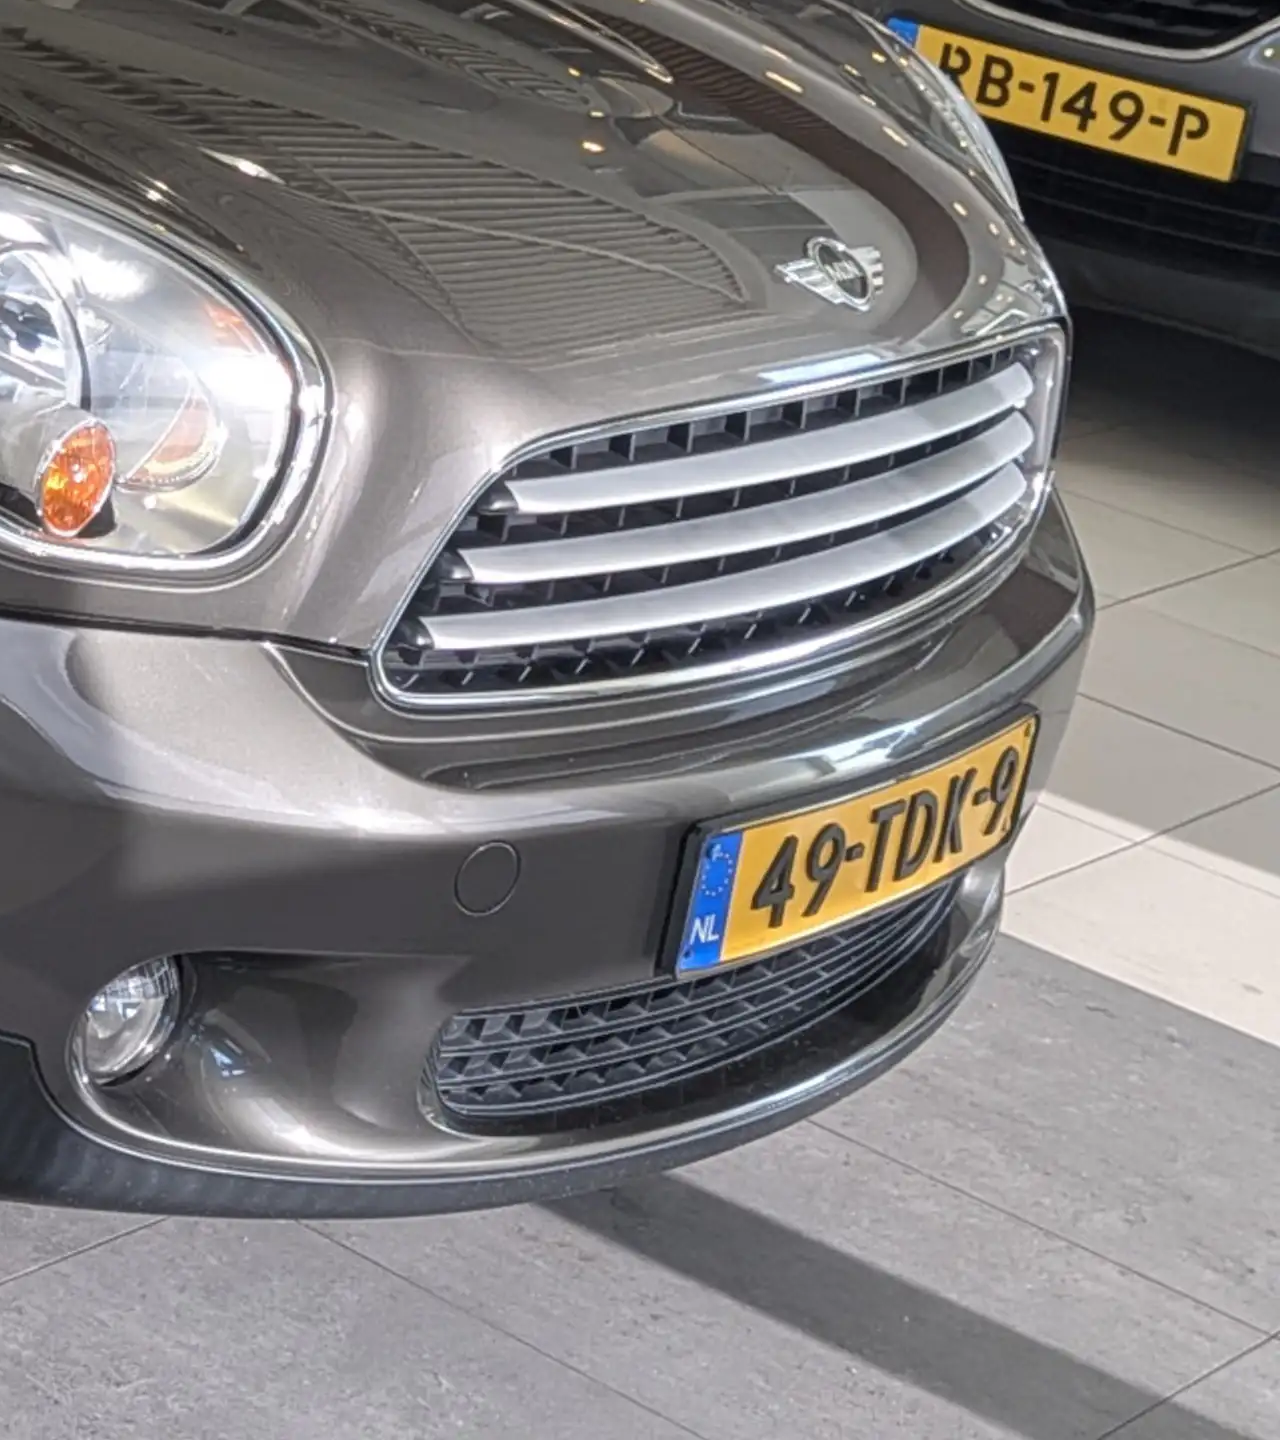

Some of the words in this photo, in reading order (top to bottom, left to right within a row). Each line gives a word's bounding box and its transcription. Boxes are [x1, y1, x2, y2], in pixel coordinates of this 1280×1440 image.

[940, 42, 1210, 156] RB-149-P
[750, 745, 1020, 929] 49-TDK-9
[689, 913, 720, 944] NL
